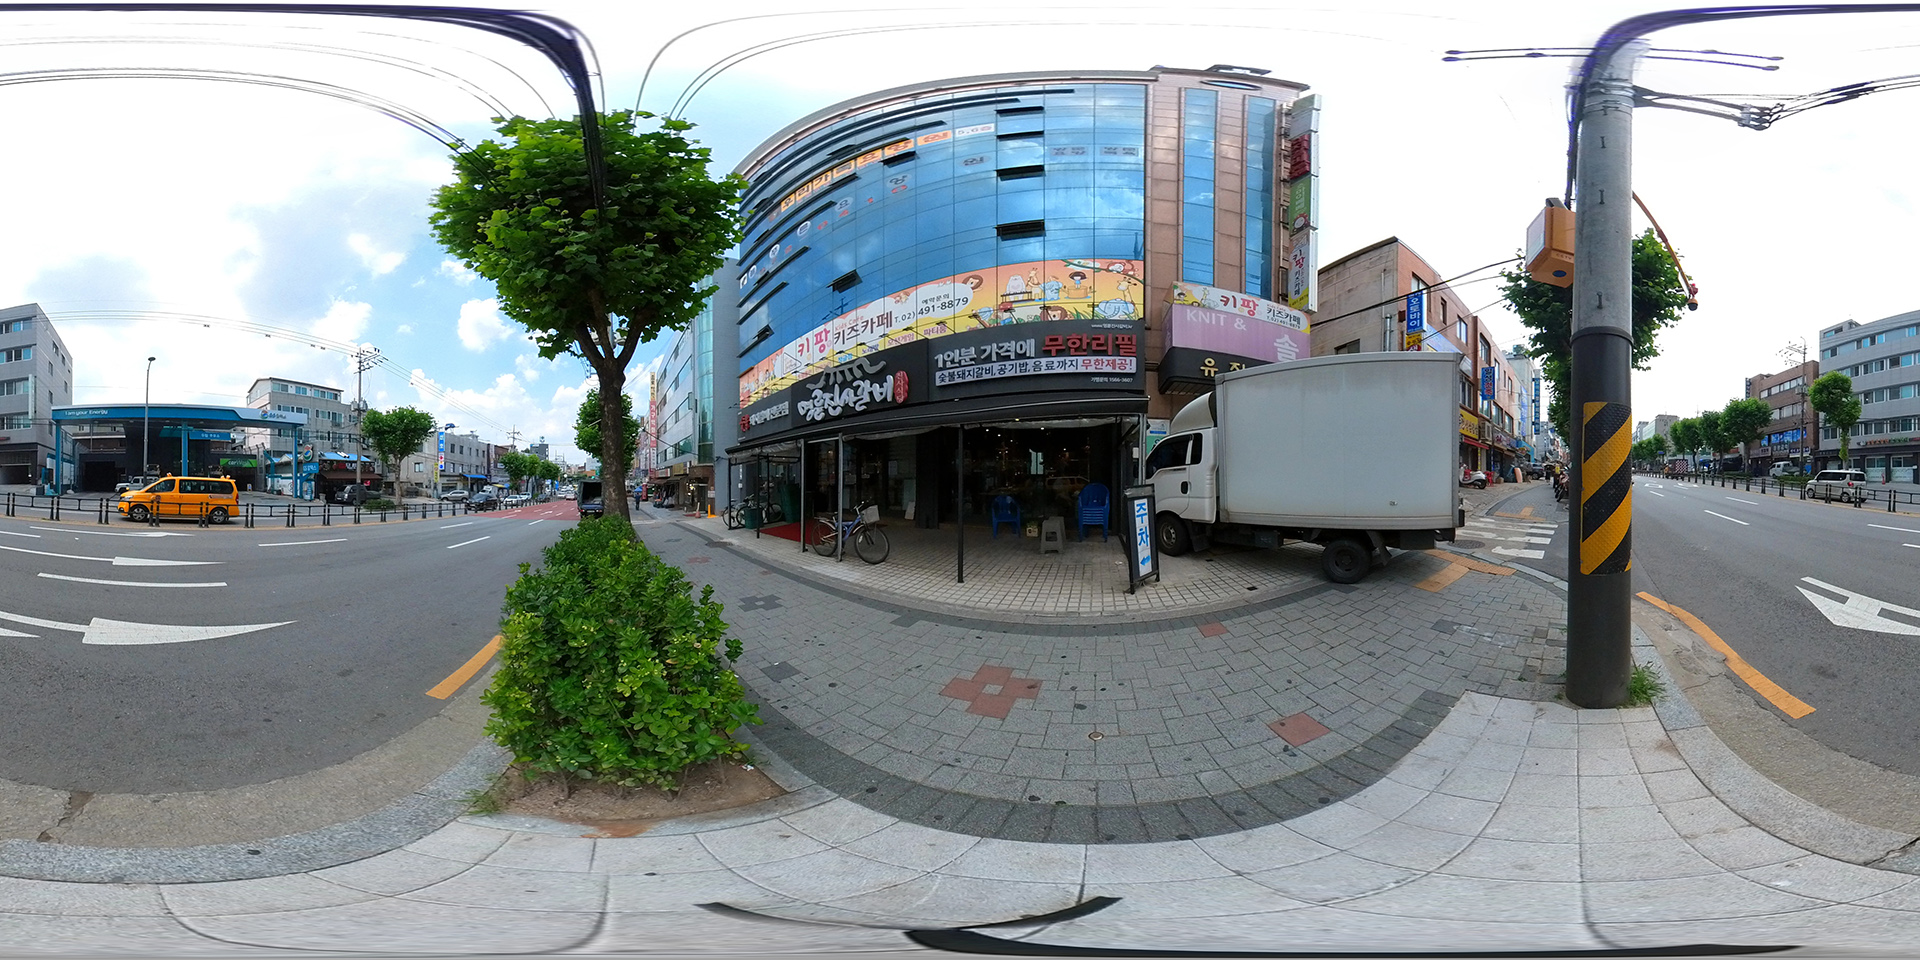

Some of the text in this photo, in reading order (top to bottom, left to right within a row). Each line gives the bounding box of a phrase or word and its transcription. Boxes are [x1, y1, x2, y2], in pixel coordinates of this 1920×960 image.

[918, 297, 969, 317] 491-8879
[921, 293, 950, 305] 예약문의
[1219, 294, 1259, 317] 키팡
[834, 310, 893, 345] 키즈카페
[1187, 309, 1246, 331] KNIT &
[1266, 307, 1301, 326] 키즈카페
[798, 328, 831, 357] 키팡
[934, 333, 1137, 369] 1인분 가격에 무한리필
[1081, 358, 1133, 371] 무한제공!
[798, 375, 894, 421] 명륜진사갈비
[1136, 502, 1149, 547] 주차
